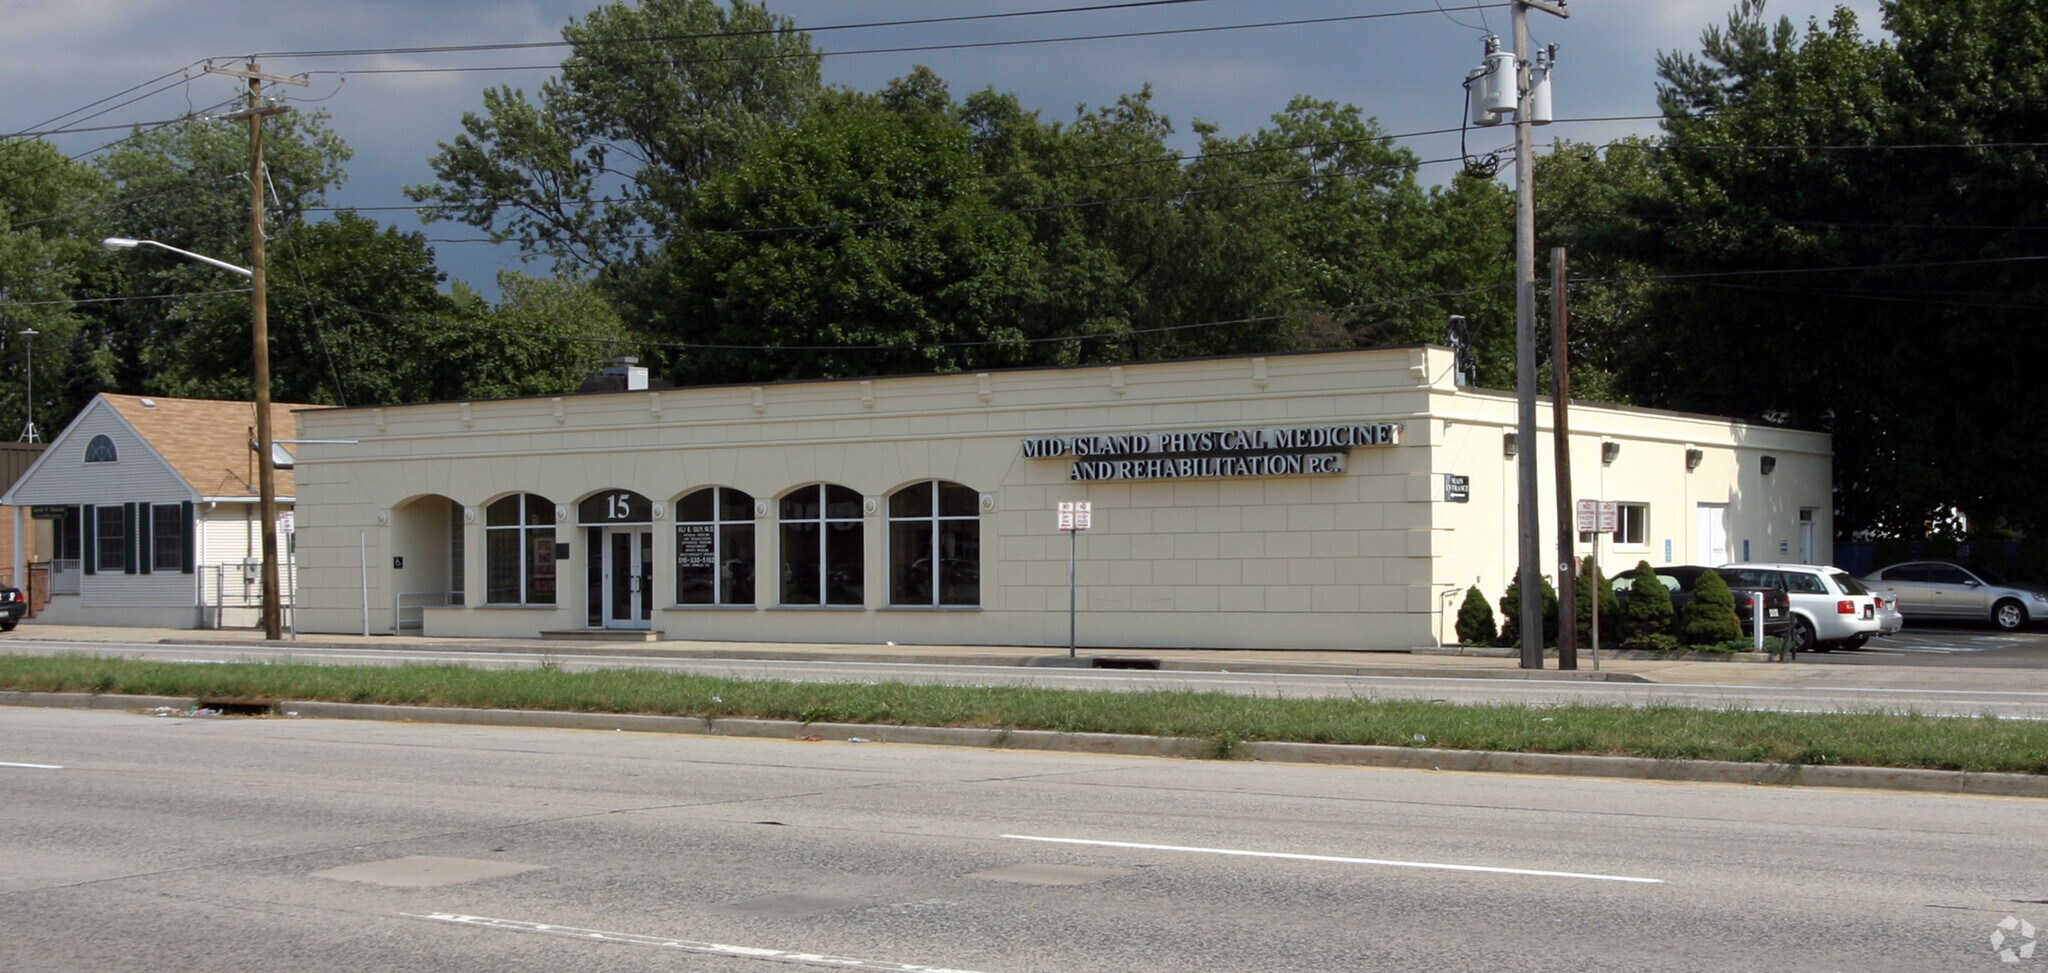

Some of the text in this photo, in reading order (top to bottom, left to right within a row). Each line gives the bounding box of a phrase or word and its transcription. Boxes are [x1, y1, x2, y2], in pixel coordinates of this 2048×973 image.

[1022, 436, 1148, 457] MID-ISLAND
[1274, 424, 1389, 448] MEDICINE
[1071, 455, 1338, 480] AND REHABILITATION P.C.
[607, 494, 630, 519] 15
